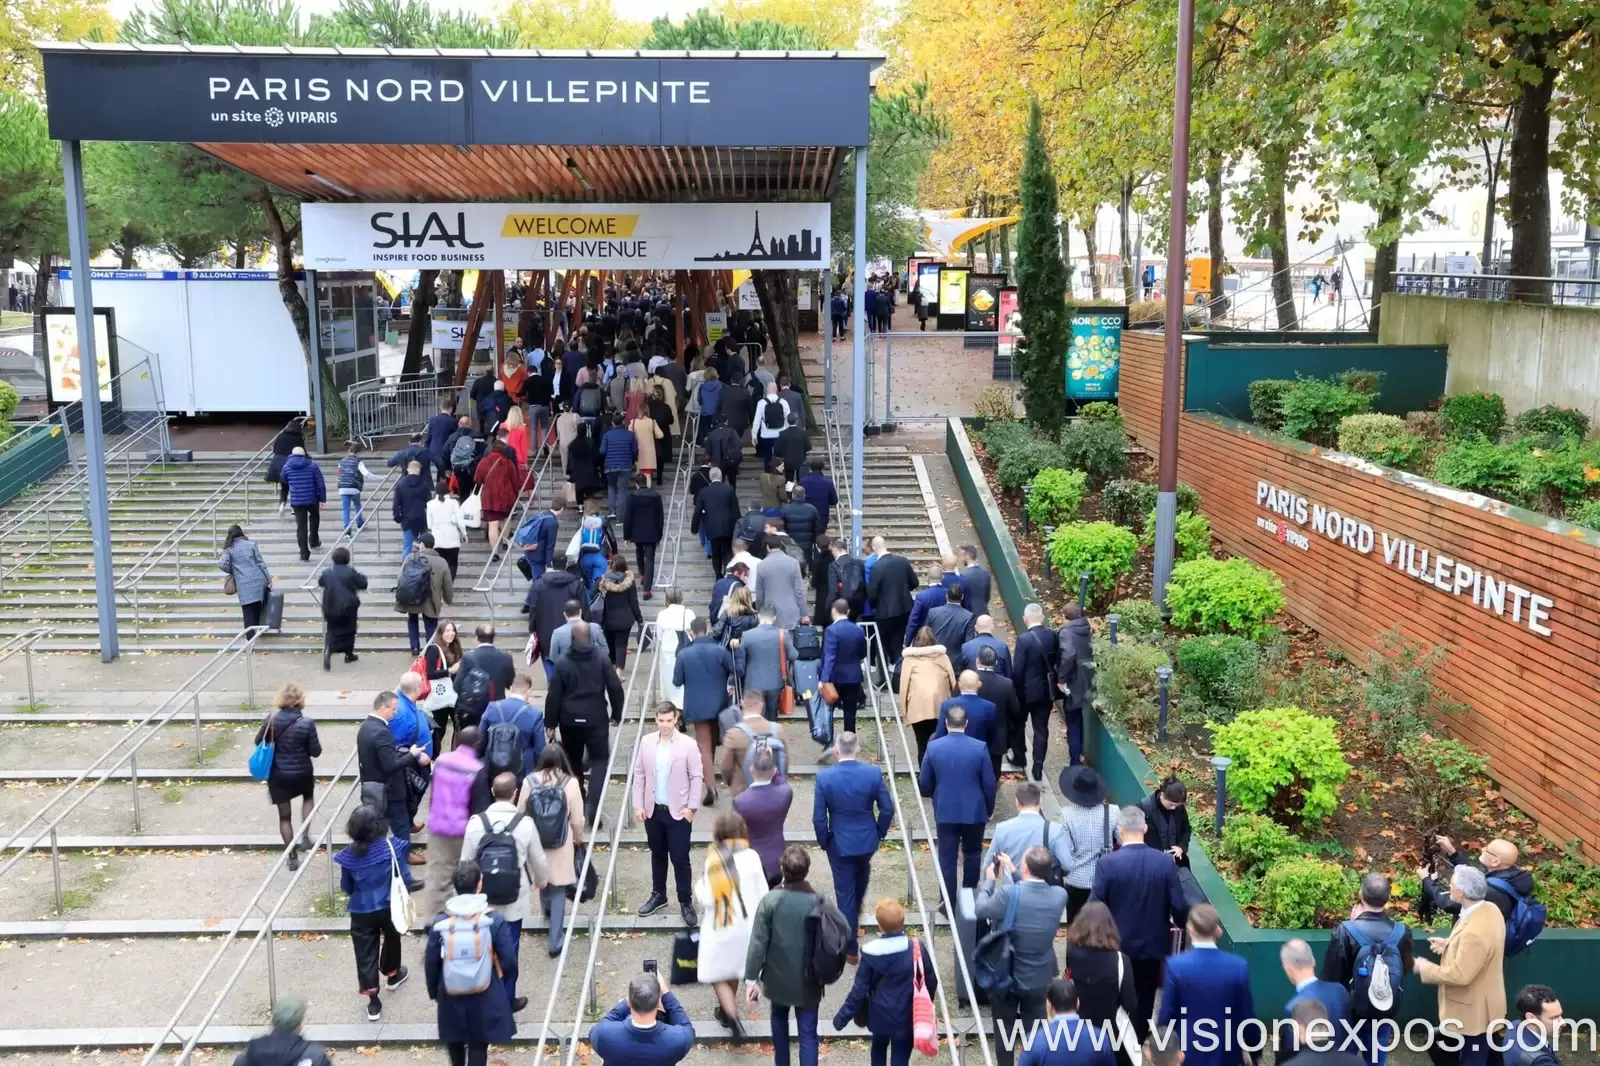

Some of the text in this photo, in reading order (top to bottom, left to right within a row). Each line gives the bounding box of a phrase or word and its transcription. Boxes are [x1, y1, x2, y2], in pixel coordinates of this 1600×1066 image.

[209, 77, 710, 103] PARIS NORD VILLEPINTE
[211, 109, 338, 123] un site VIPARIS
[371, 211, 485, 249] SIAL
[513, 217, 616, 235] WELCOME
[411, 254, 438, 262] FOOD
[441, 254, 485, 262] BUSINESS
[543, 241, 647, 257] BIENVENUE
[1256, 480, 1553, 637] PARIS NORD VILLEPINTE
